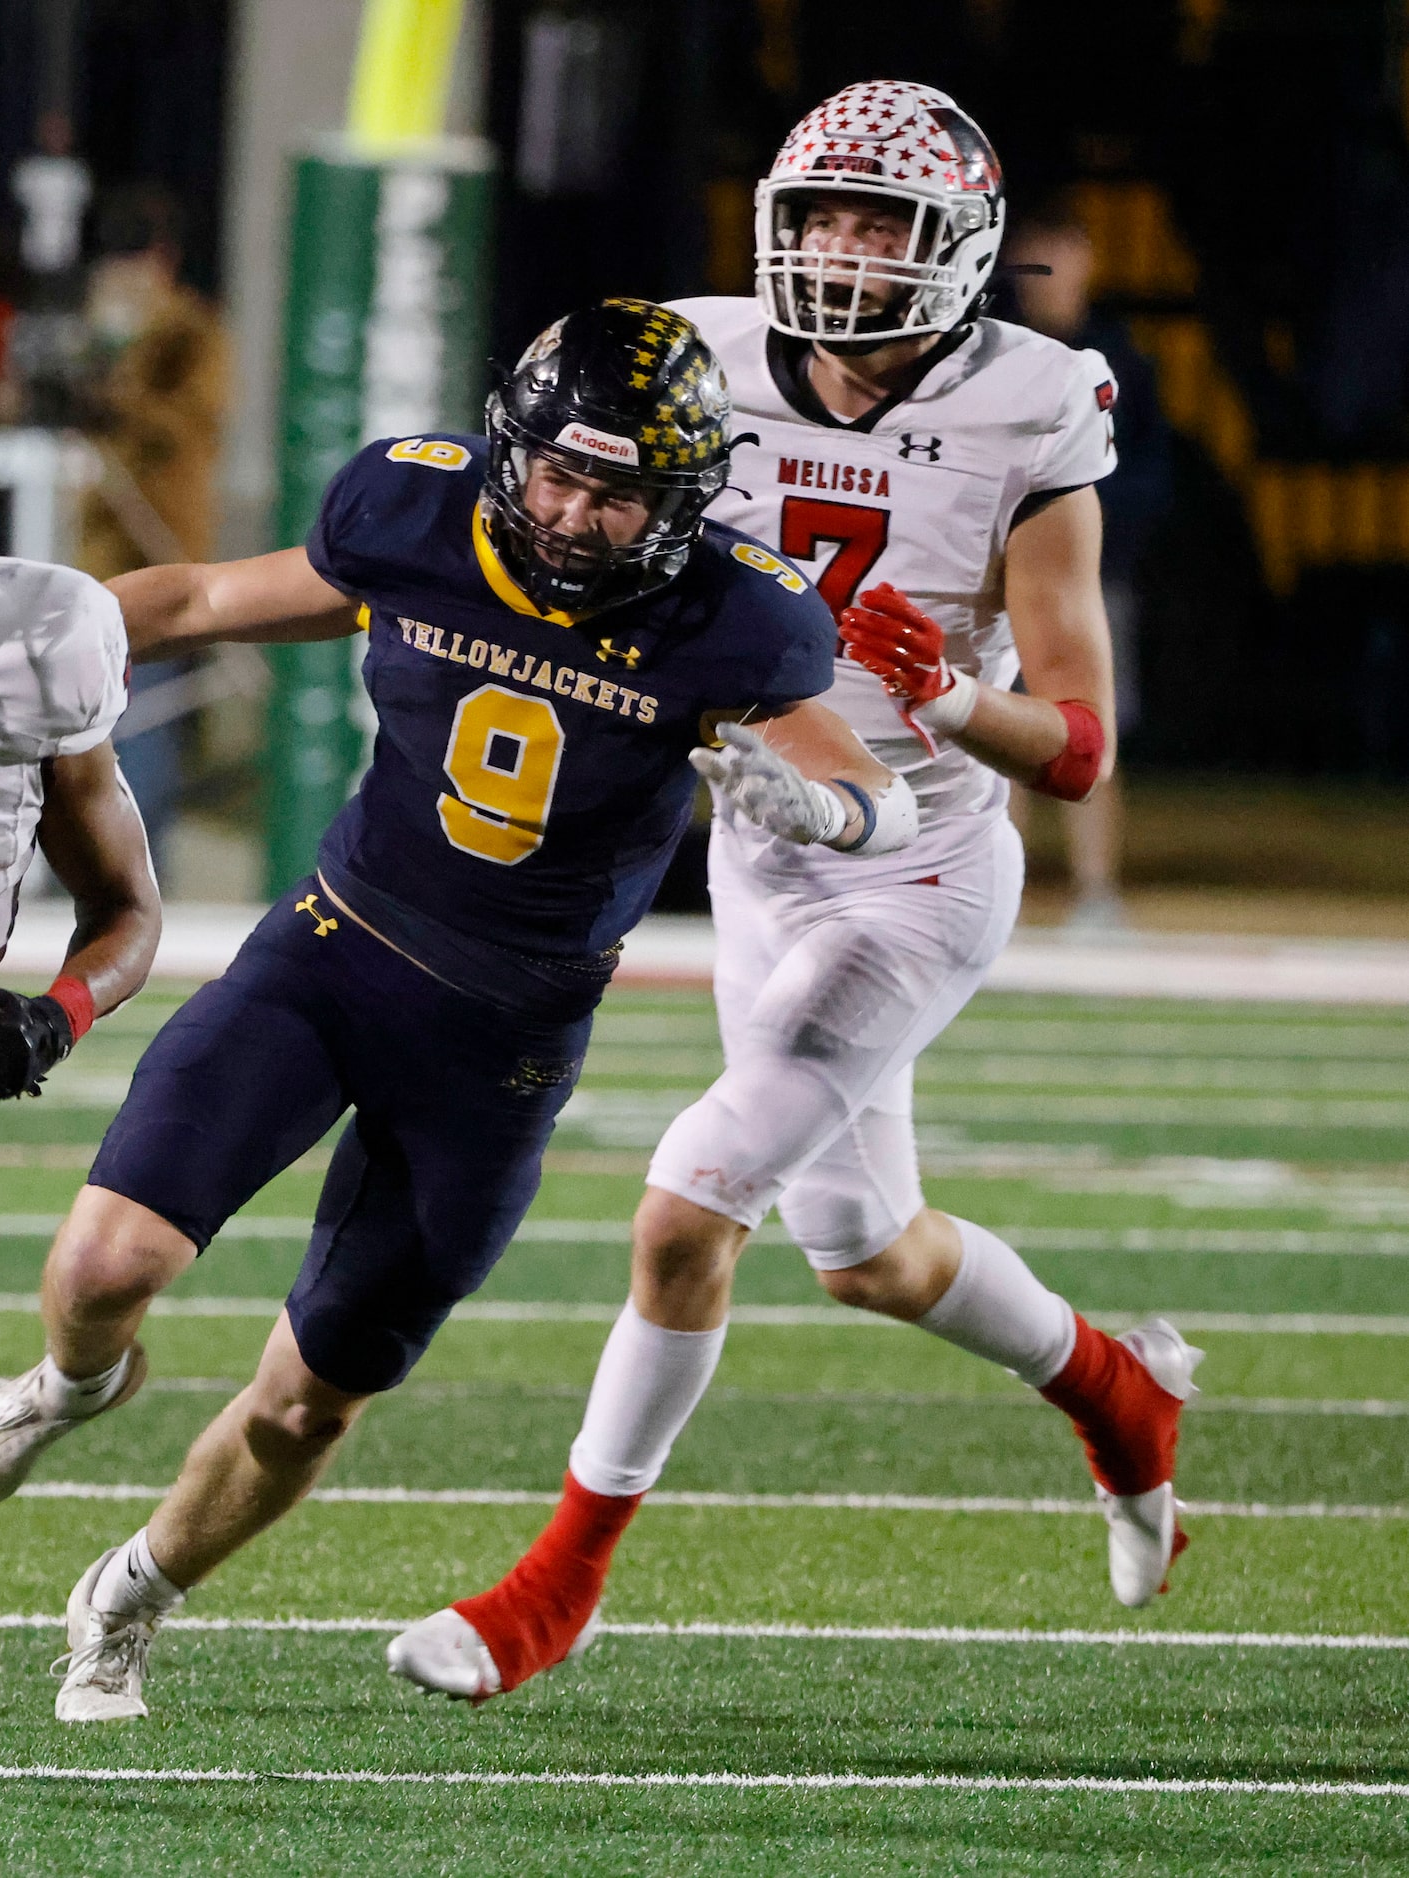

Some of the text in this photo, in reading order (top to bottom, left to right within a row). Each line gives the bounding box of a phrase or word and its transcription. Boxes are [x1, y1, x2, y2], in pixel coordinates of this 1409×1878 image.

[385, 438, 472, 471] 9
[778, 457, 889, 497] MELISSA
[730, 542, 809, 595] 9
[780, 495, 891, 658] 7
[397, 616, 659, 724] YELLOWJACKETS
[436, 683, 566, 866] 9
